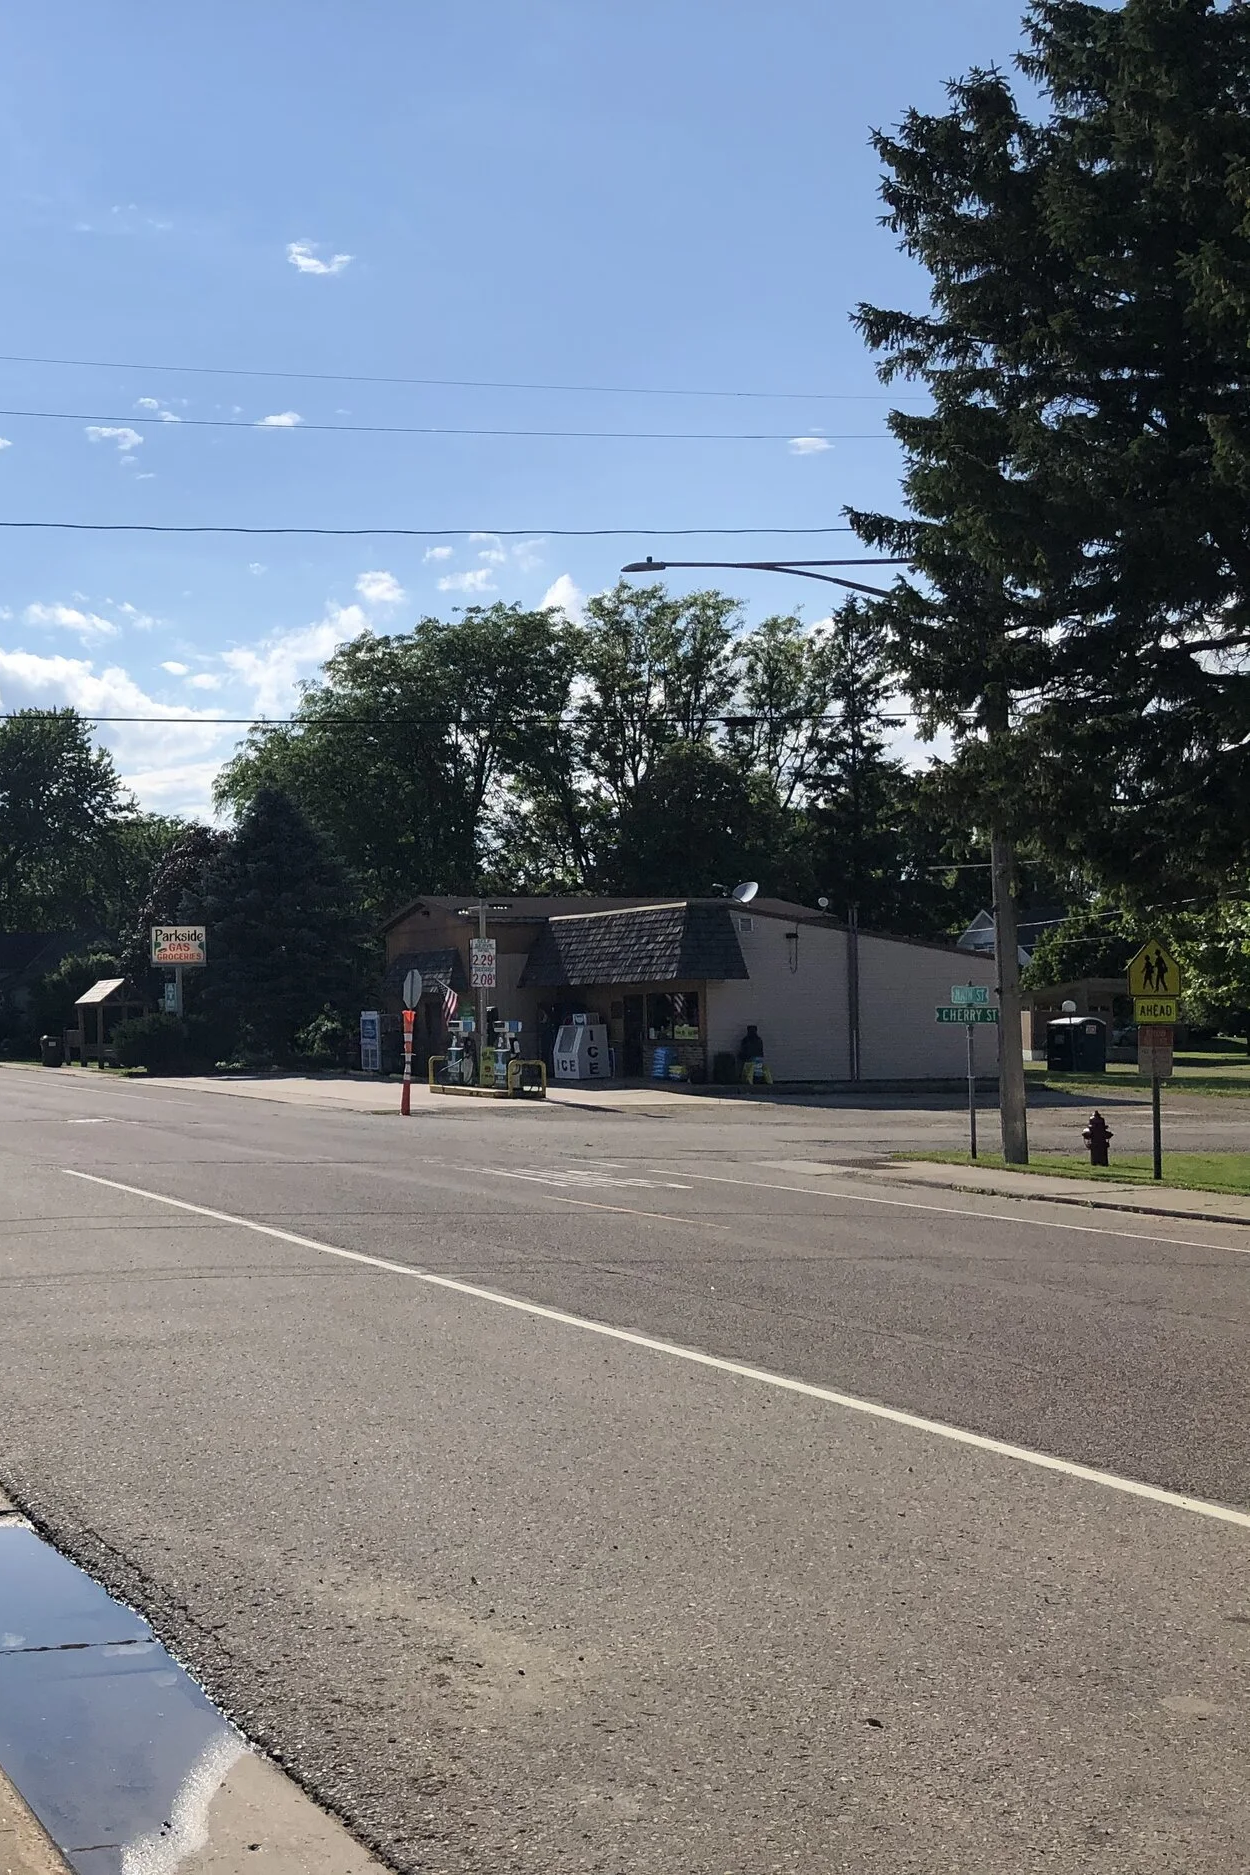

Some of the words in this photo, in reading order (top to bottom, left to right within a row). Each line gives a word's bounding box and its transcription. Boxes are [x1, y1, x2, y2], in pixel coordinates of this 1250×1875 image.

[155, 929, 204, 942] Parkside
[168, 943, 191, 952] GAS
[157, 953, 202, 961] GROCERIES
[954, 988, 973, 1001] MAIN
[976, 989, 986, 1001] ST
[942, 1009, 982, 1021] CHERRY
[986, 1009, 997, 1021] ST
[1140, 1004, 1172, 1017] AHEAD
[587, 1029, 599, 1075] ICE
[556, 1059, 576, 1072] ICE
